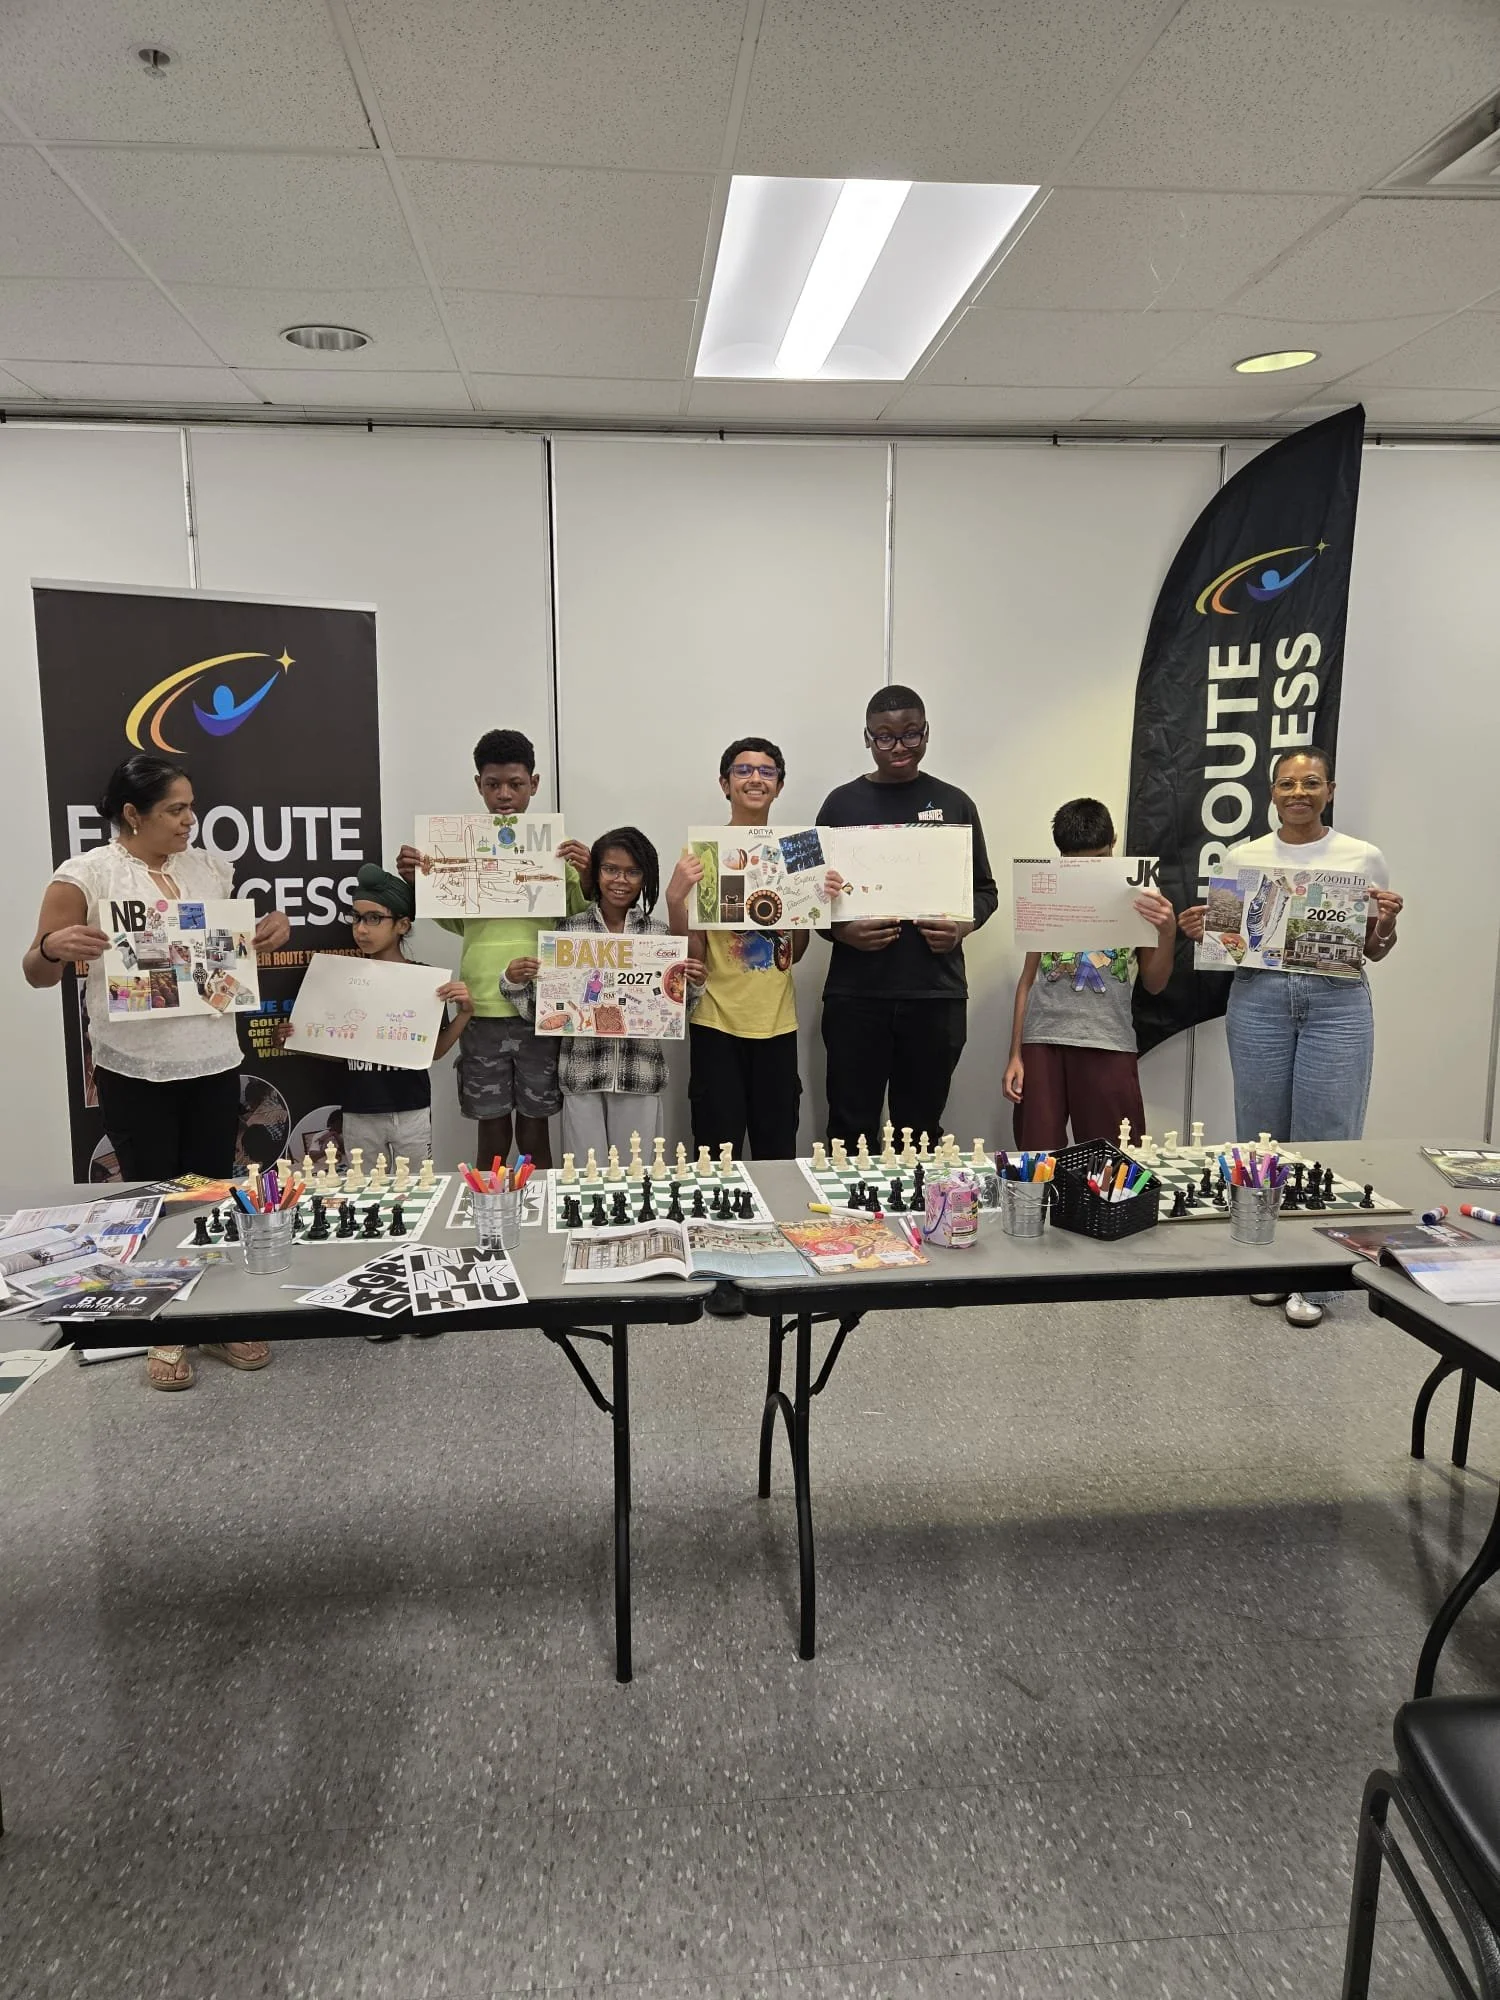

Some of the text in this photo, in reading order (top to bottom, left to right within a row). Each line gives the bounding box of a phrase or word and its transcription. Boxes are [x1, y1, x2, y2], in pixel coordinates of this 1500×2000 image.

[190, 804, 364, 862] OUTE
[527, 823, 552, 852] M
[1126, 859, 1160, 887] JK
[1314, 872, 1366, 886] Zoom In
[525, 885, 543, 913] Y
[110, 900, 147, 932] NB
[1307, 908, 1346, 923] 2026
[273, 950, 304, 966] ROUTE
[555, 937, 634, 969] BAKE
[617, 972, 653, 985] 2027
[250, 1018, 281, 1028] GOLF
[248, 1029, 274, 1038] CHE
[252, 1037, 273, 1048] ME
[77, 1295, 148, 1306] BOLD
